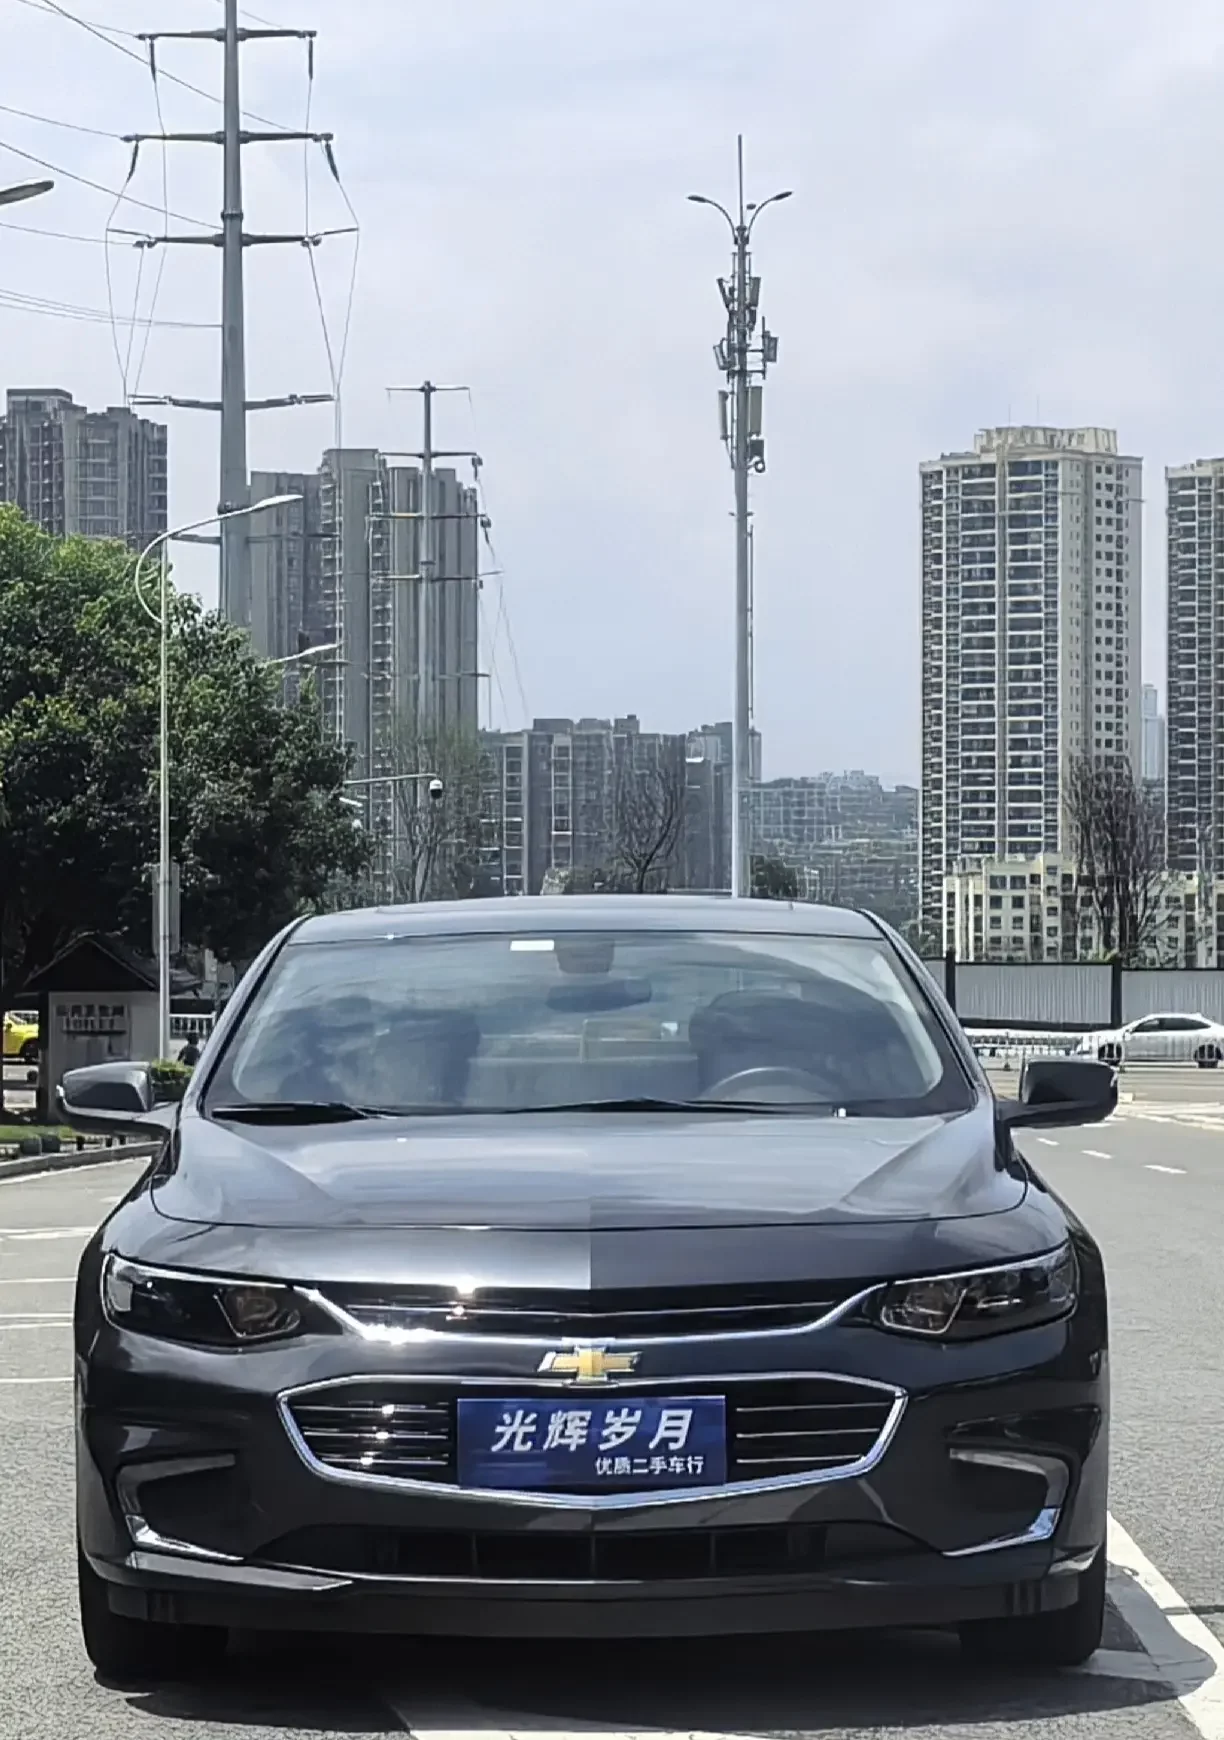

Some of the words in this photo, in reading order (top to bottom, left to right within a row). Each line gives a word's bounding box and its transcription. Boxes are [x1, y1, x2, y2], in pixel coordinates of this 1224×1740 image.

[491, 1408, 693, 1451] 光辉岁月
[595, 1456, 704, 1475] 优质二手车行
